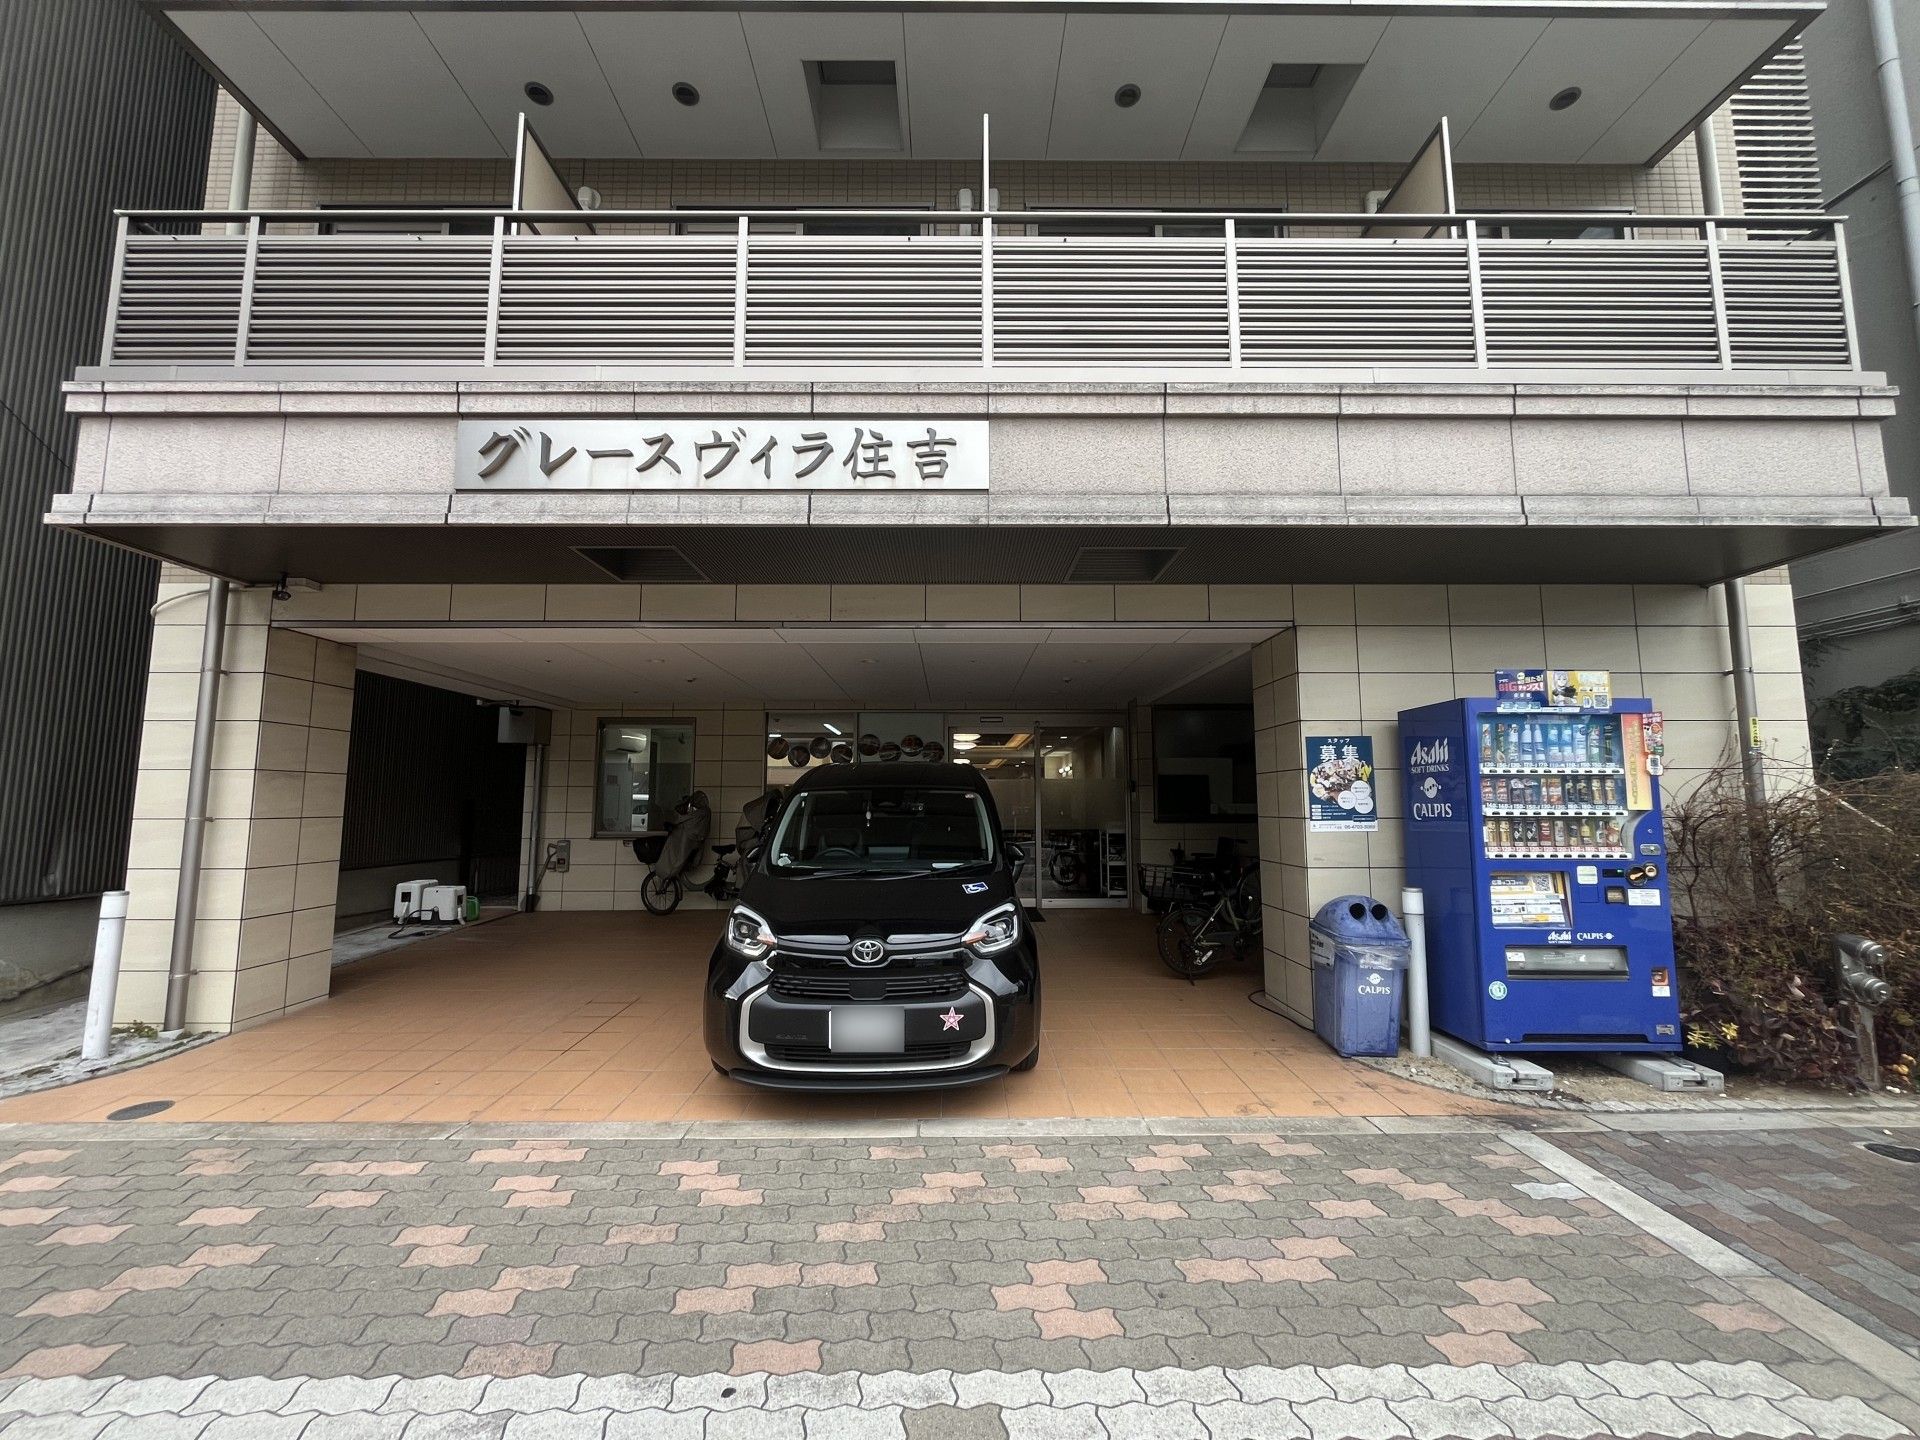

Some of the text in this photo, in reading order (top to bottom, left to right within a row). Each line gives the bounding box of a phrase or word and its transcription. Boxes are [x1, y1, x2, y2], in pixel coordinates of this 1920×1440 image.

[477, 425, 957, 481] グレースヴィラ住吉
[1320, 745, 1359, 763] 募集
[1410, 737, 1449, 765] Asahi
[1426, 764, 1450, 773] DRINKS
[1413, 803, 1452, 820] CALPIS
[1547, 930, 1572, 941] Asahi
[1576, 932, 1604, 941] CALPIS
[1357, 985, 1391, 995] CALPIS
